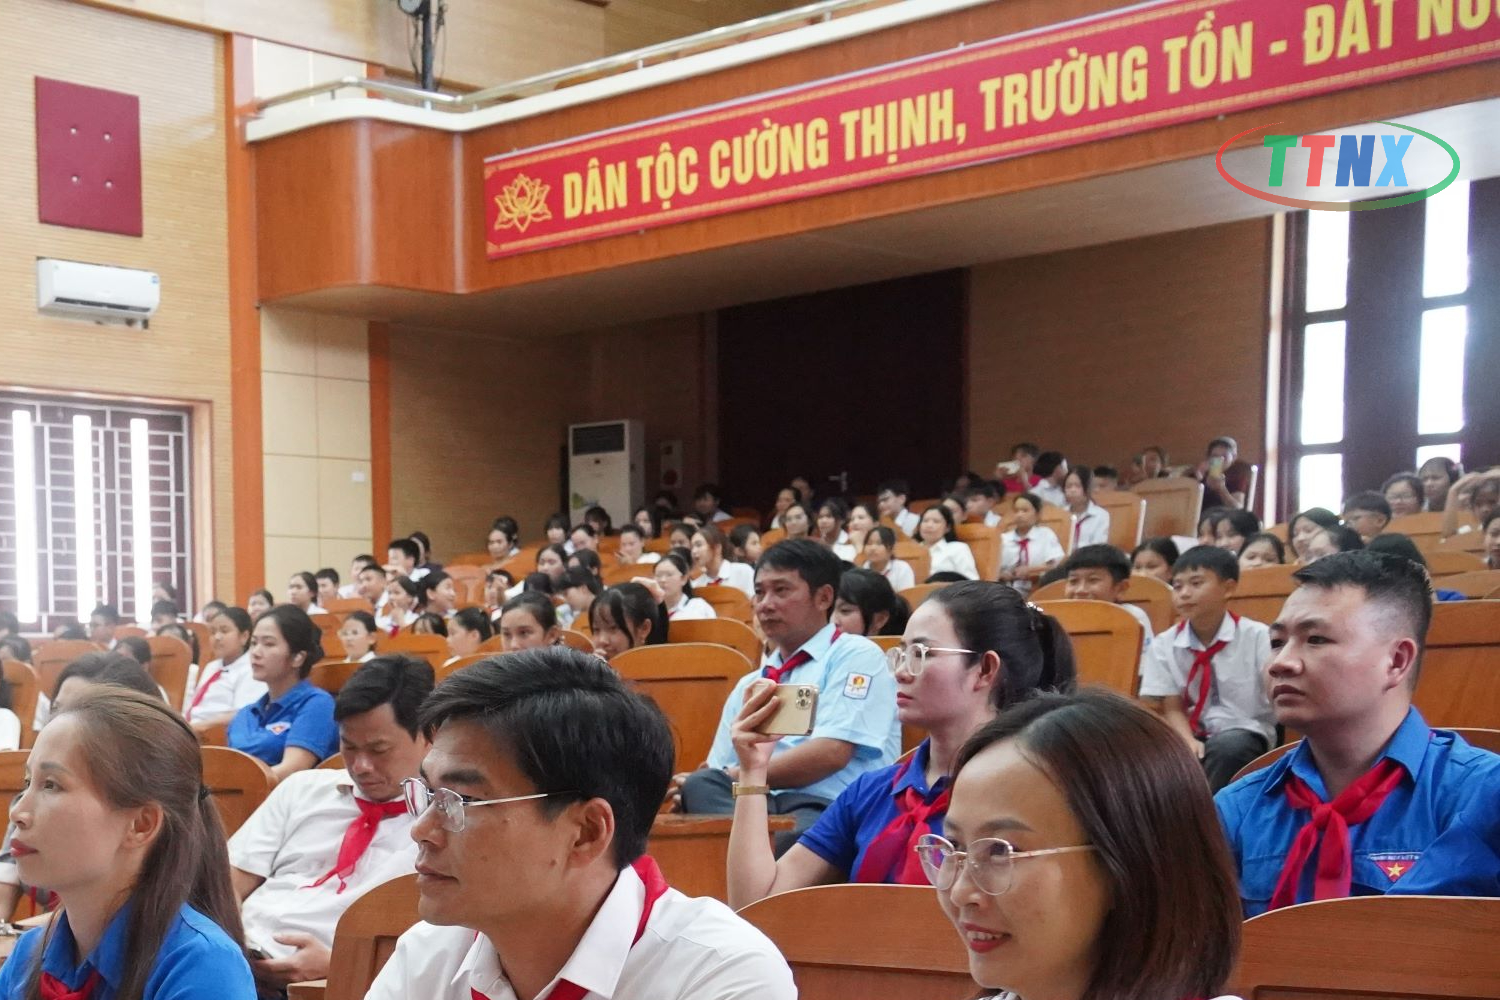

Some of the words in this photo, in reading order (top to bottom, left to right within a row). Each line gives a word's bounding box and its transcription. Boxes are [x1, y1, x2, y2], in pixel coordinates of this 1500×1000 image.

[563, 157, 628, 220] DÂN
[637, 142, 699, 210] TỘC
[709, 117, 829, 189] CƯỜNG
[840, 88, 967, 164] THỊNH,
[979, 46, 1149, 132] TRƯỜNG
[1163, 11, 1253, 94] TỒN
